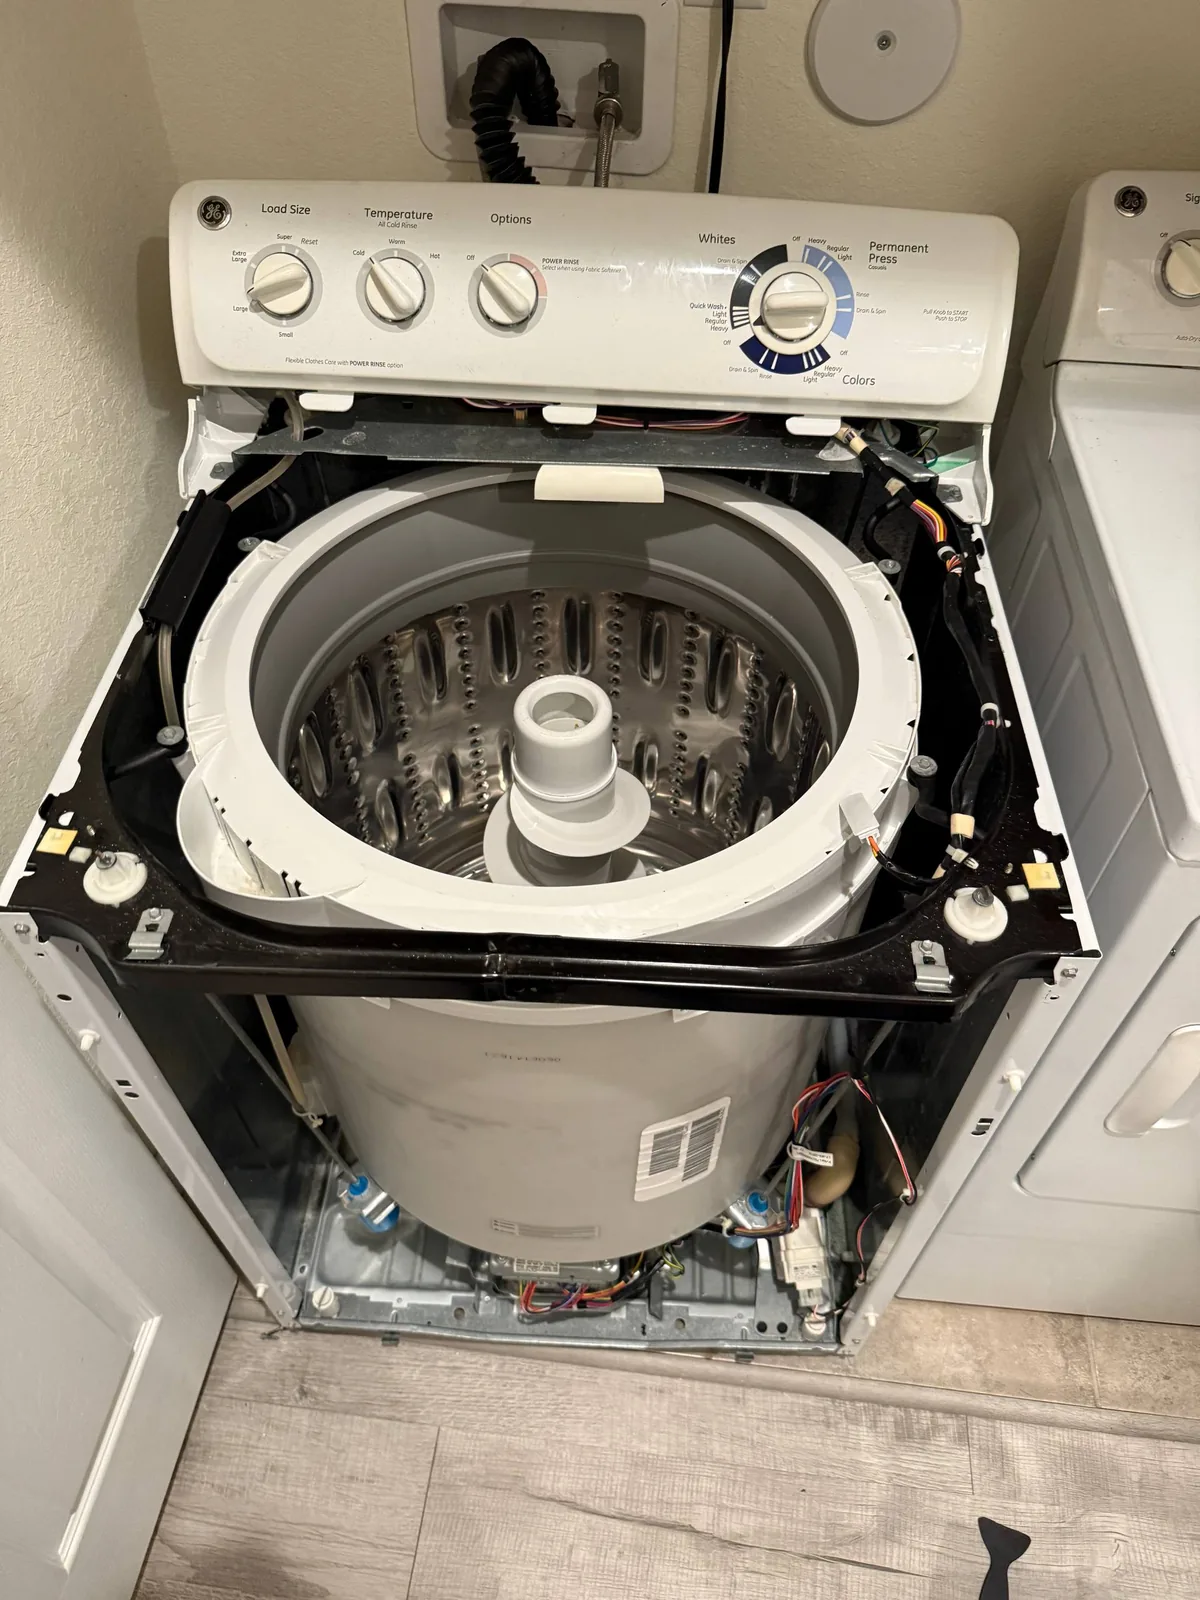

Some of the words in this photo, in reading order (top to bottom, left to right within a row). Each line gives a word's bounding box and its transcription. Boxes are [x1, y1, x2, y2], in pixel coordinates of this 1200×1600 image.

[262, 204, 286, 214] Load
[290, 204, 310, 215] Size
[364, 208, 433, 221] Temperature
[490, 214, 532, 226] Options
[699, 233, 736, 245] Whites
[808, 237, 827, 245] Heavy
[869, 242, 929, 254] Permanent
[868, 254, 897, 264] Press
[824, 365, 842, 373] Heavy
[842, 374, 876, 386] Colors
